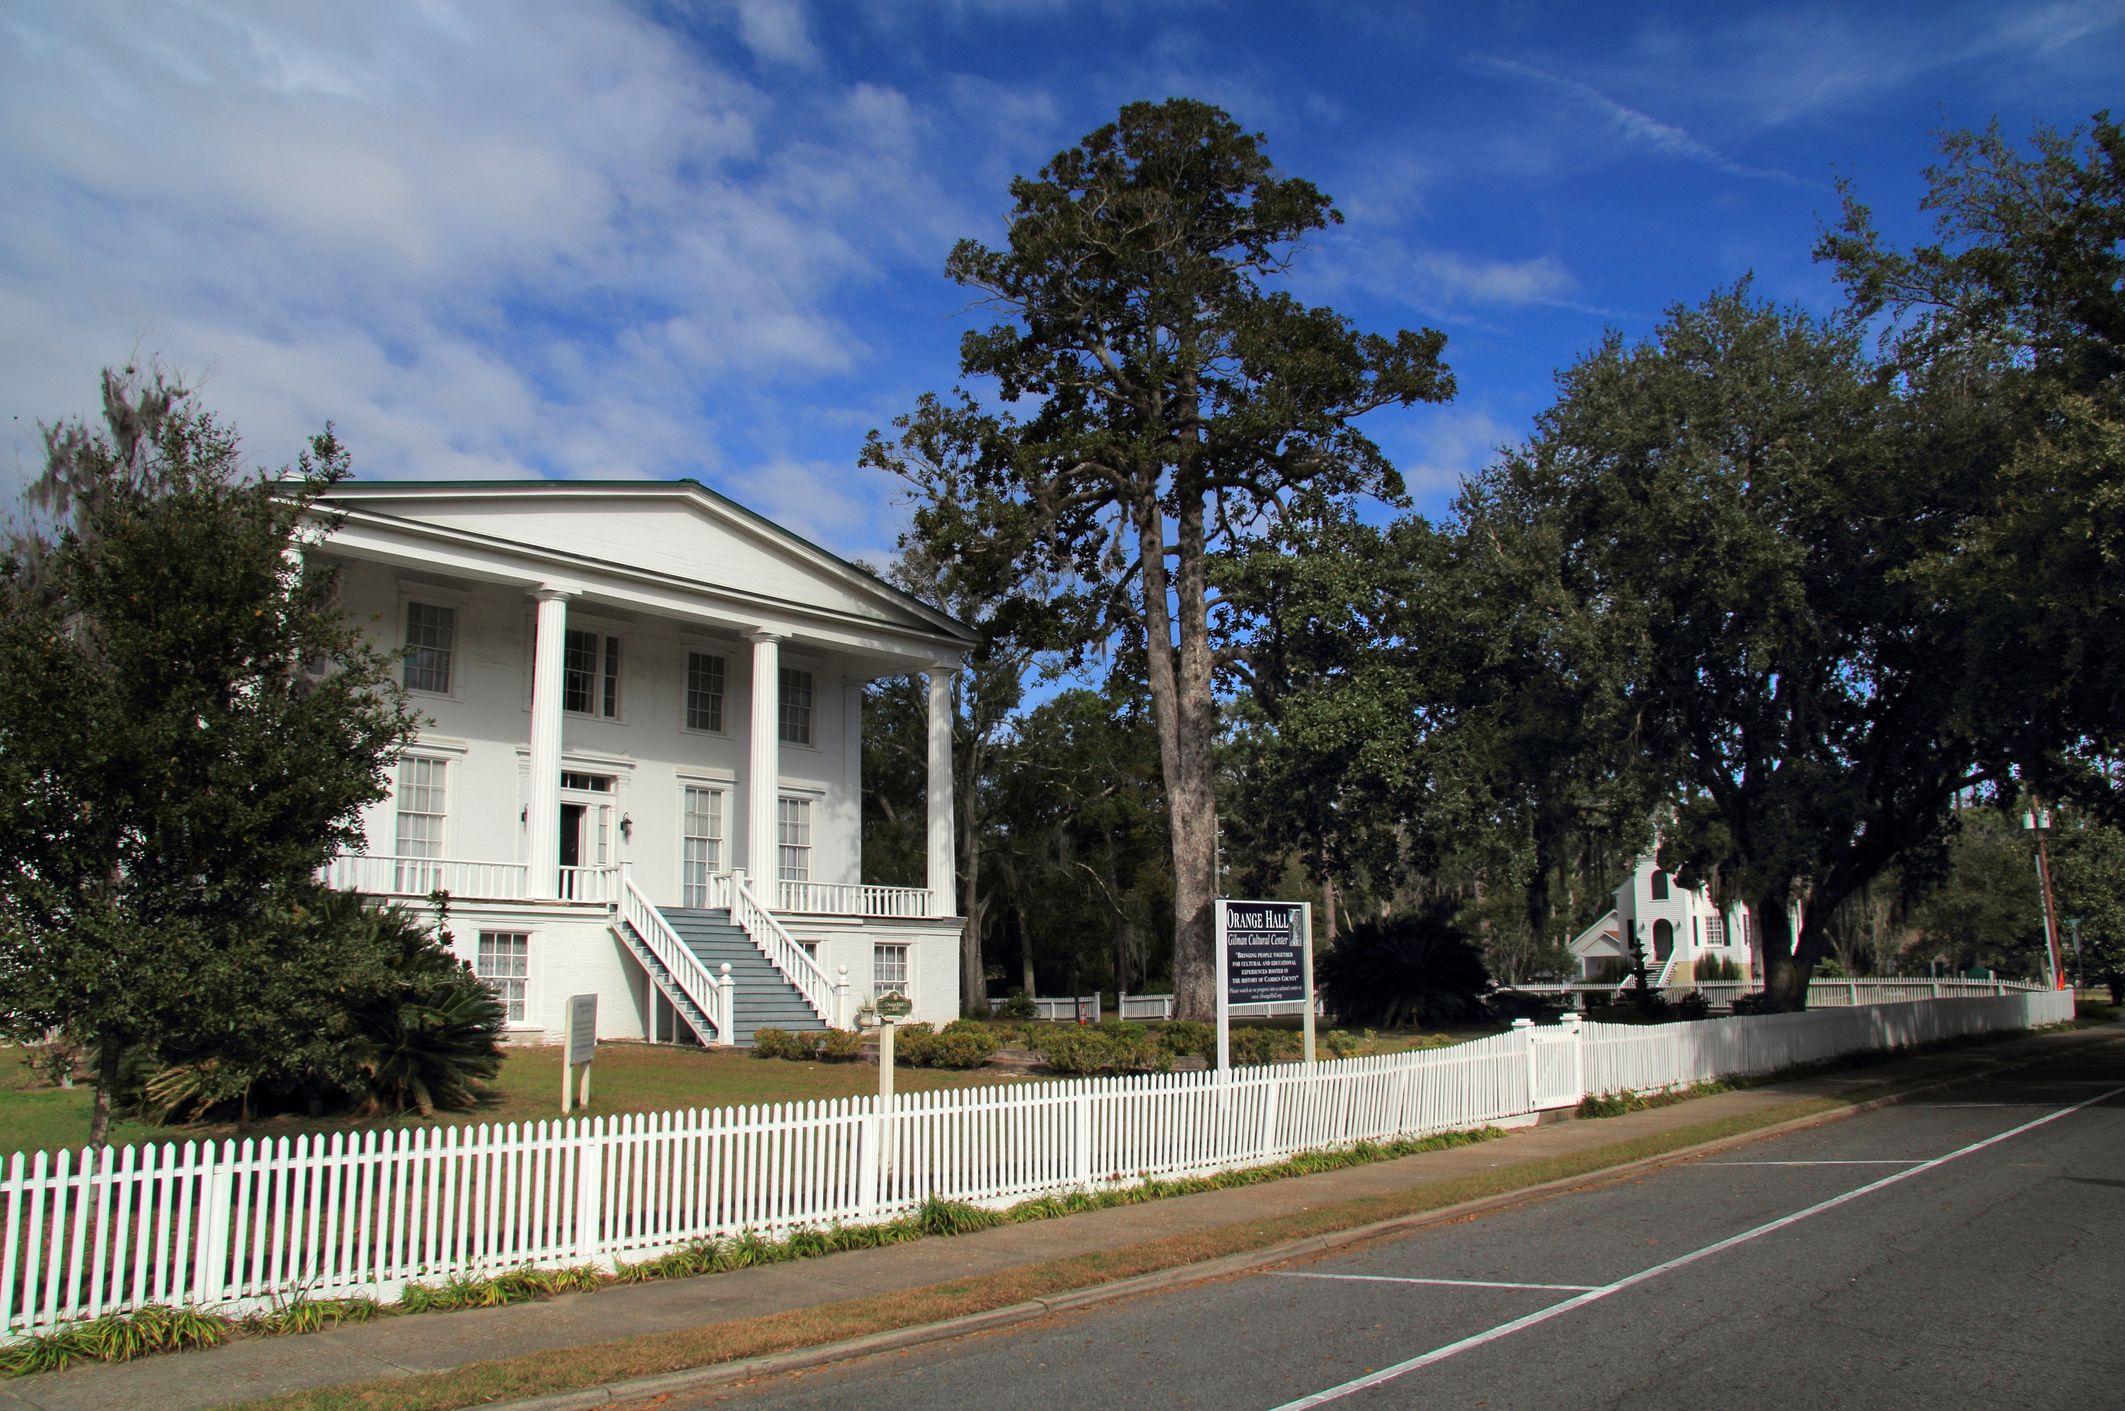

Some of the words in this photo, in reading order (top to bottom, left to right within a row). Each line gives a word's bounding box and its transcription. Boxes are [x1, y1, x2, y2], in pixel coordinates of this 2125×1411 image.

[1227, 908, 1263, 928] ORANGE
[1266, 910, 1288, 928] HALL
[1228, 934, 1247, 946] Gilman
[1248, 934, 1270, 945] Cultural
[1271, 934, 1288, 945] Center
